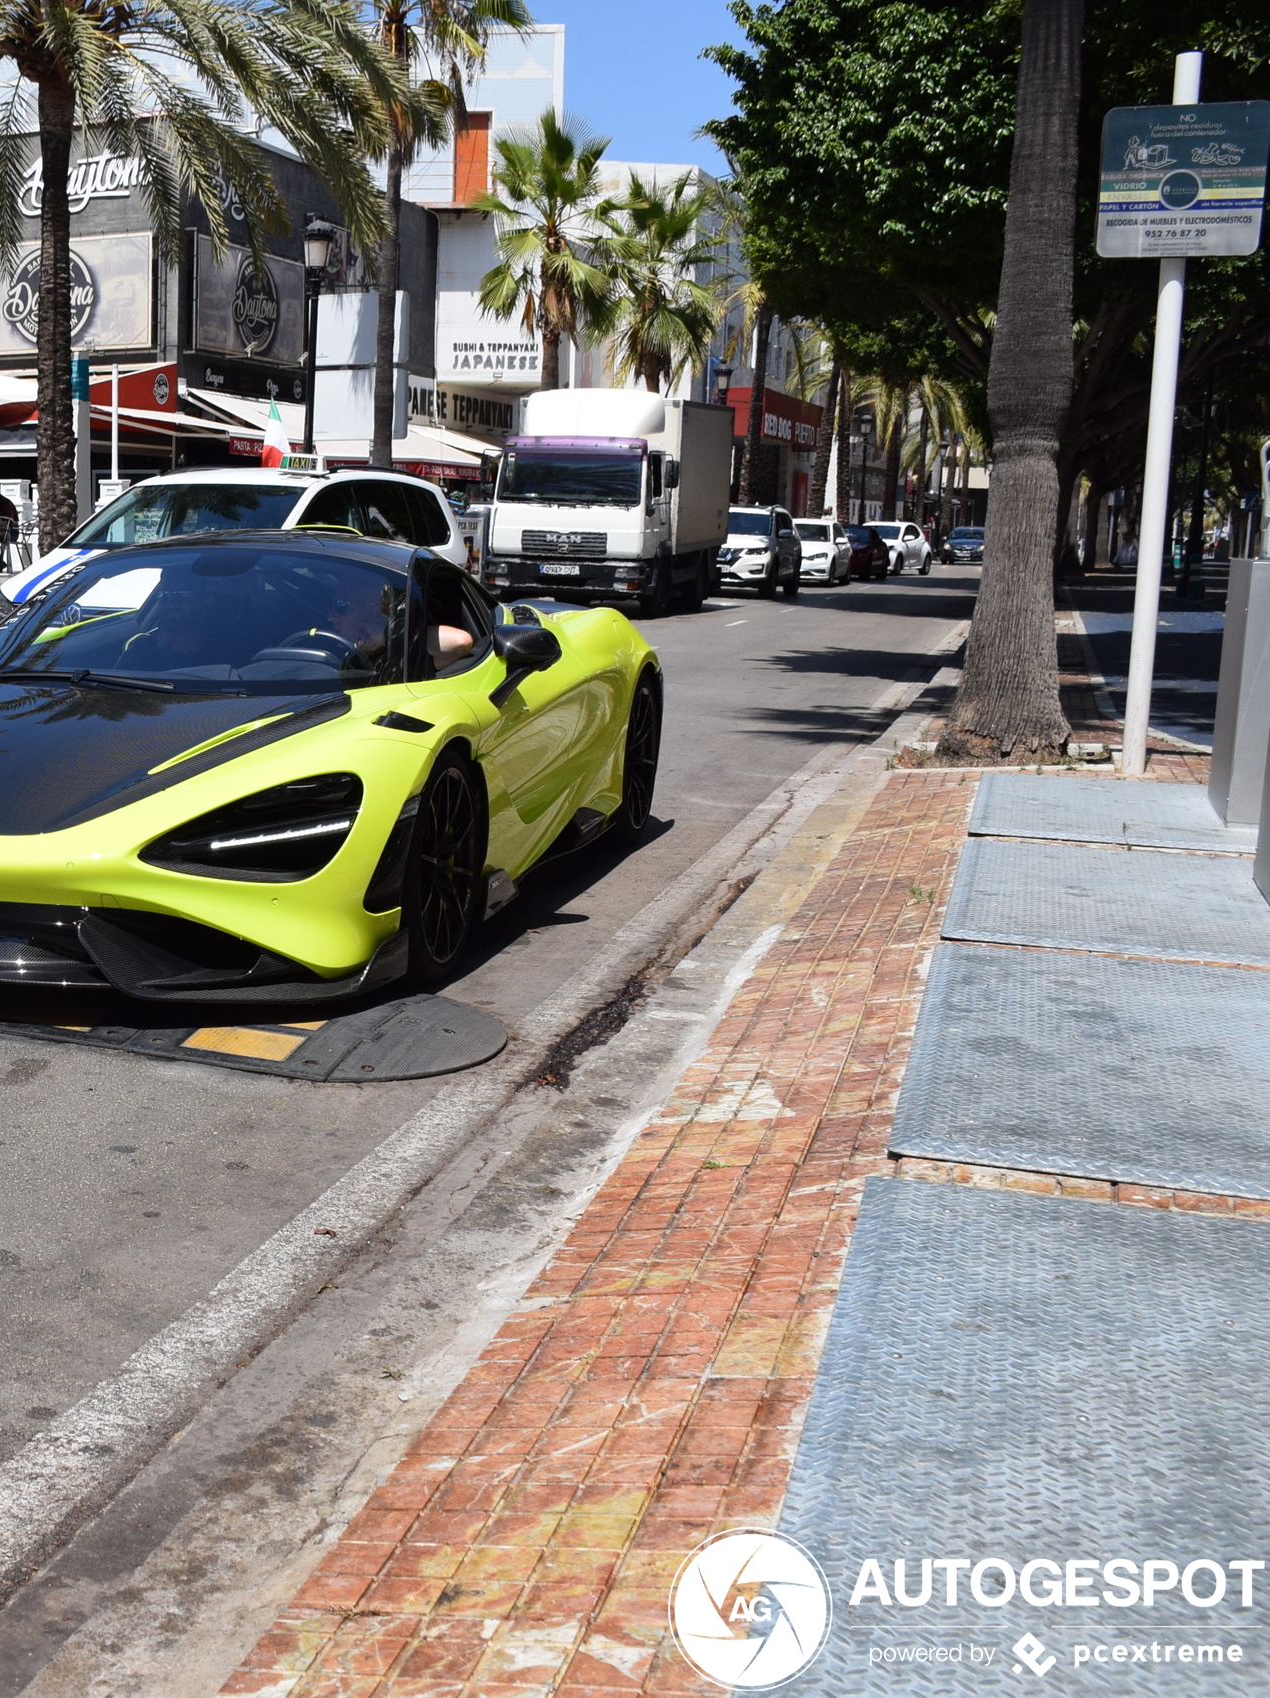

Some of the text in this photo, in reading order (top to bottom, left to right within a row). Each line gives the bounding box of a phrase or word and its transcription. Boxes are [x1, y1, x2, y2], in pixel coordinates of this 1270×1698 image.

[1179, 114, 1197, 123] NO
[1150, 130, 1171, 138] fuera
[1183, 128, 1228, 137] contenedor
[1113, 182, 1147, 191] VIDRIO
[1099, 203, 1121, 211] PAPEL
[1106, 214, 1253, 227] RECOGIDA DE MUEBLES Y ELECTRODOMÉSTICOS
[1144, 228, 1207, 238] 952 76 87 20
[232, 285, 278, 328] Daytona
[452, 342, 539, 353] SUSHI & TEPPANYAKI
[452, 354, 539, 370] JAPANESE
[408, 386, 447, 420] PANESE
[233, 440, 251, 452] PASTA
[290, 457, 310, 469] TAXI
[545, 534, 582, 544] MAN
[32, 565, 86, 602] DRIVE
